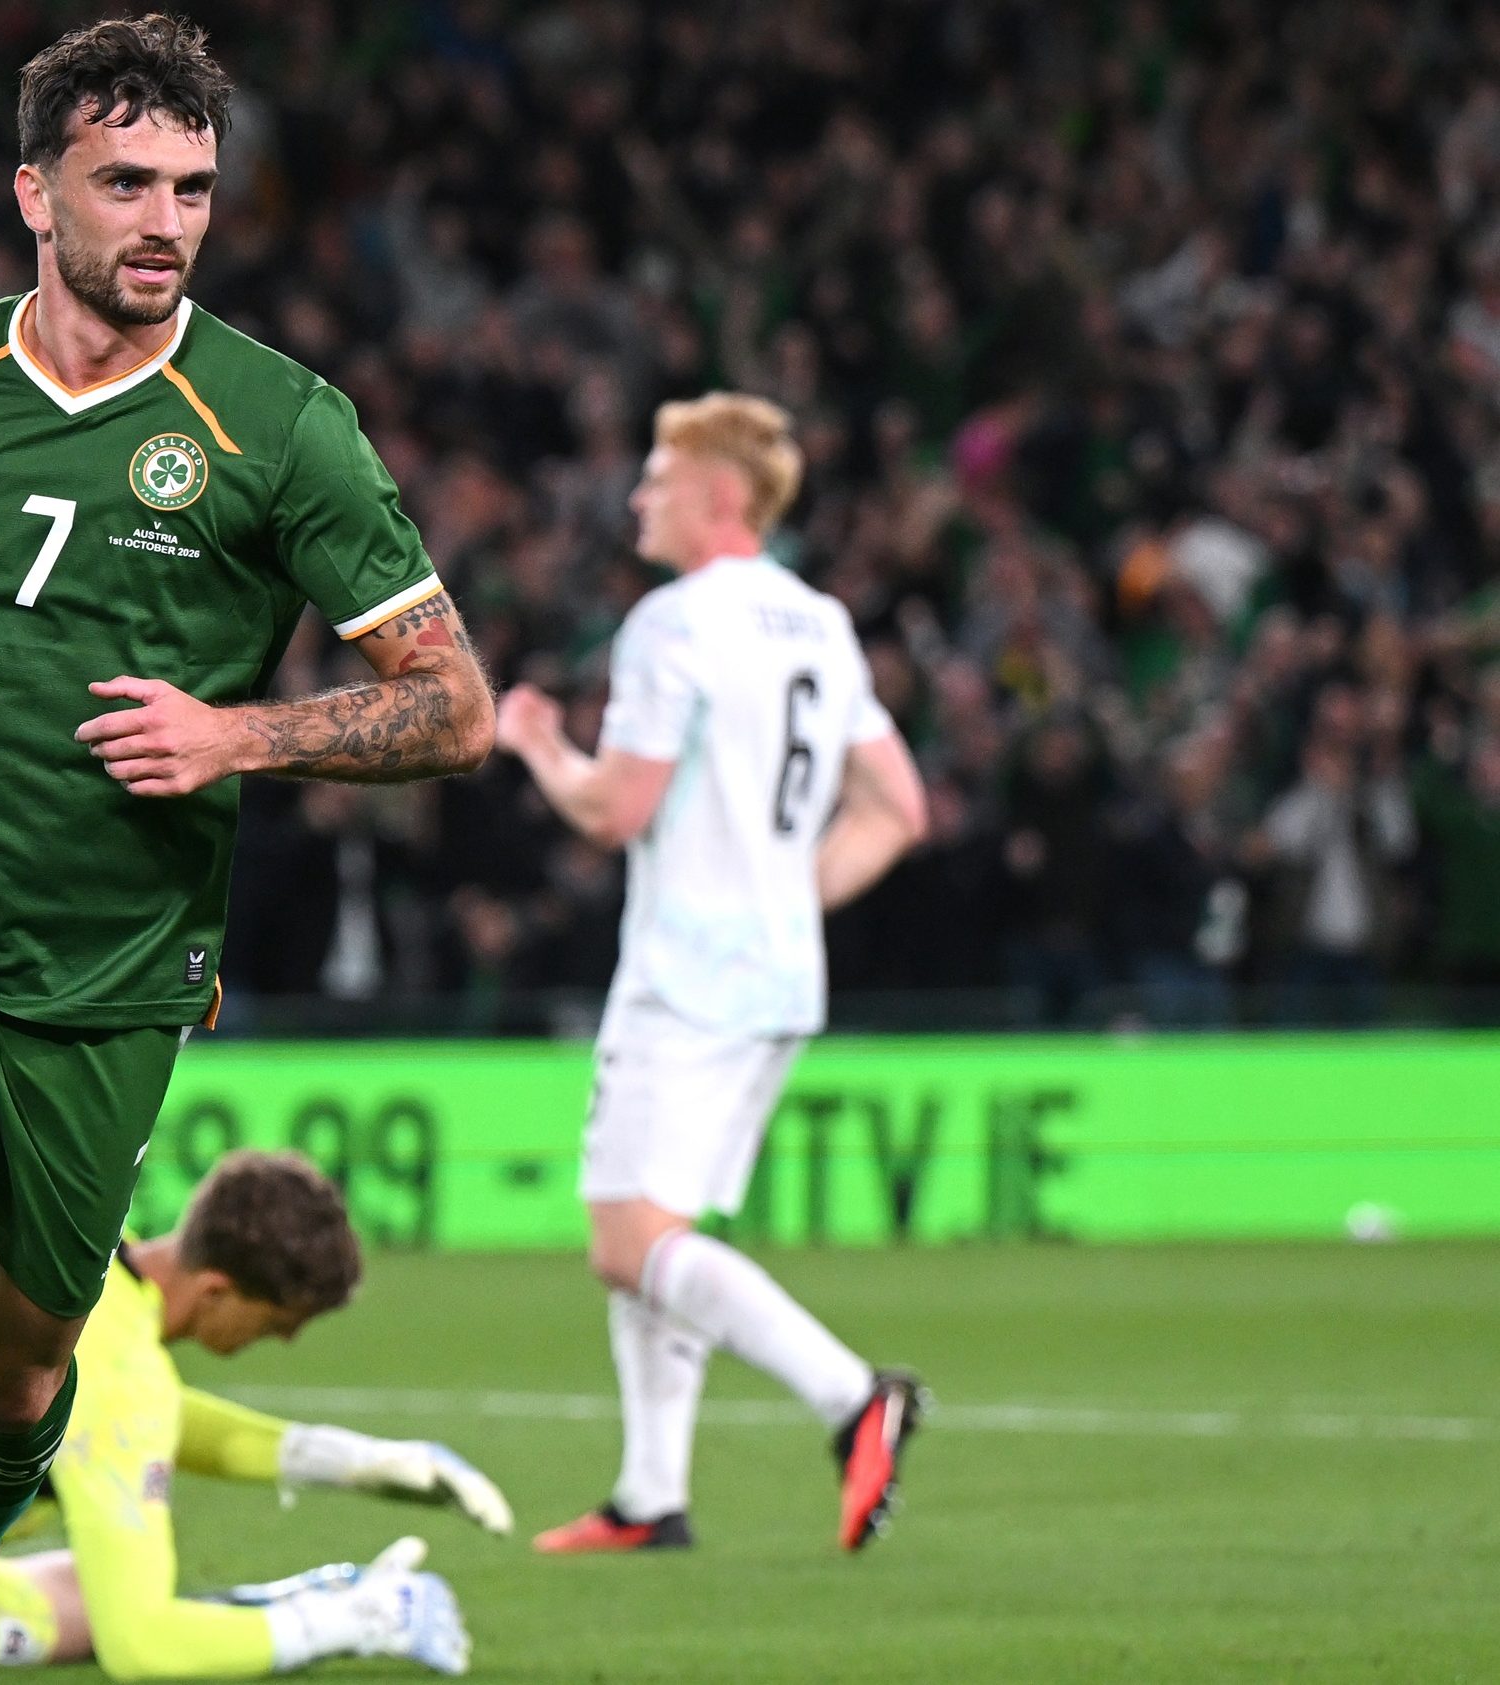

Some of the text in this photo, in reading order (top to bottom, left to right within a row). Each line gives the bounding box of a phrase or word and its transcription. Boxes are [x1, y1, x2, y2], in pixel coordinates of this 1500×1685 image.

[141, 438, 202, 465] IRELAND
[108, 535, 200, 558] 1st OCTOBER 2026
[133, 528, 178, 544] AUSTRIA
[15, 494, 77, 608] 7
[773, 671, 819, 834] 6
